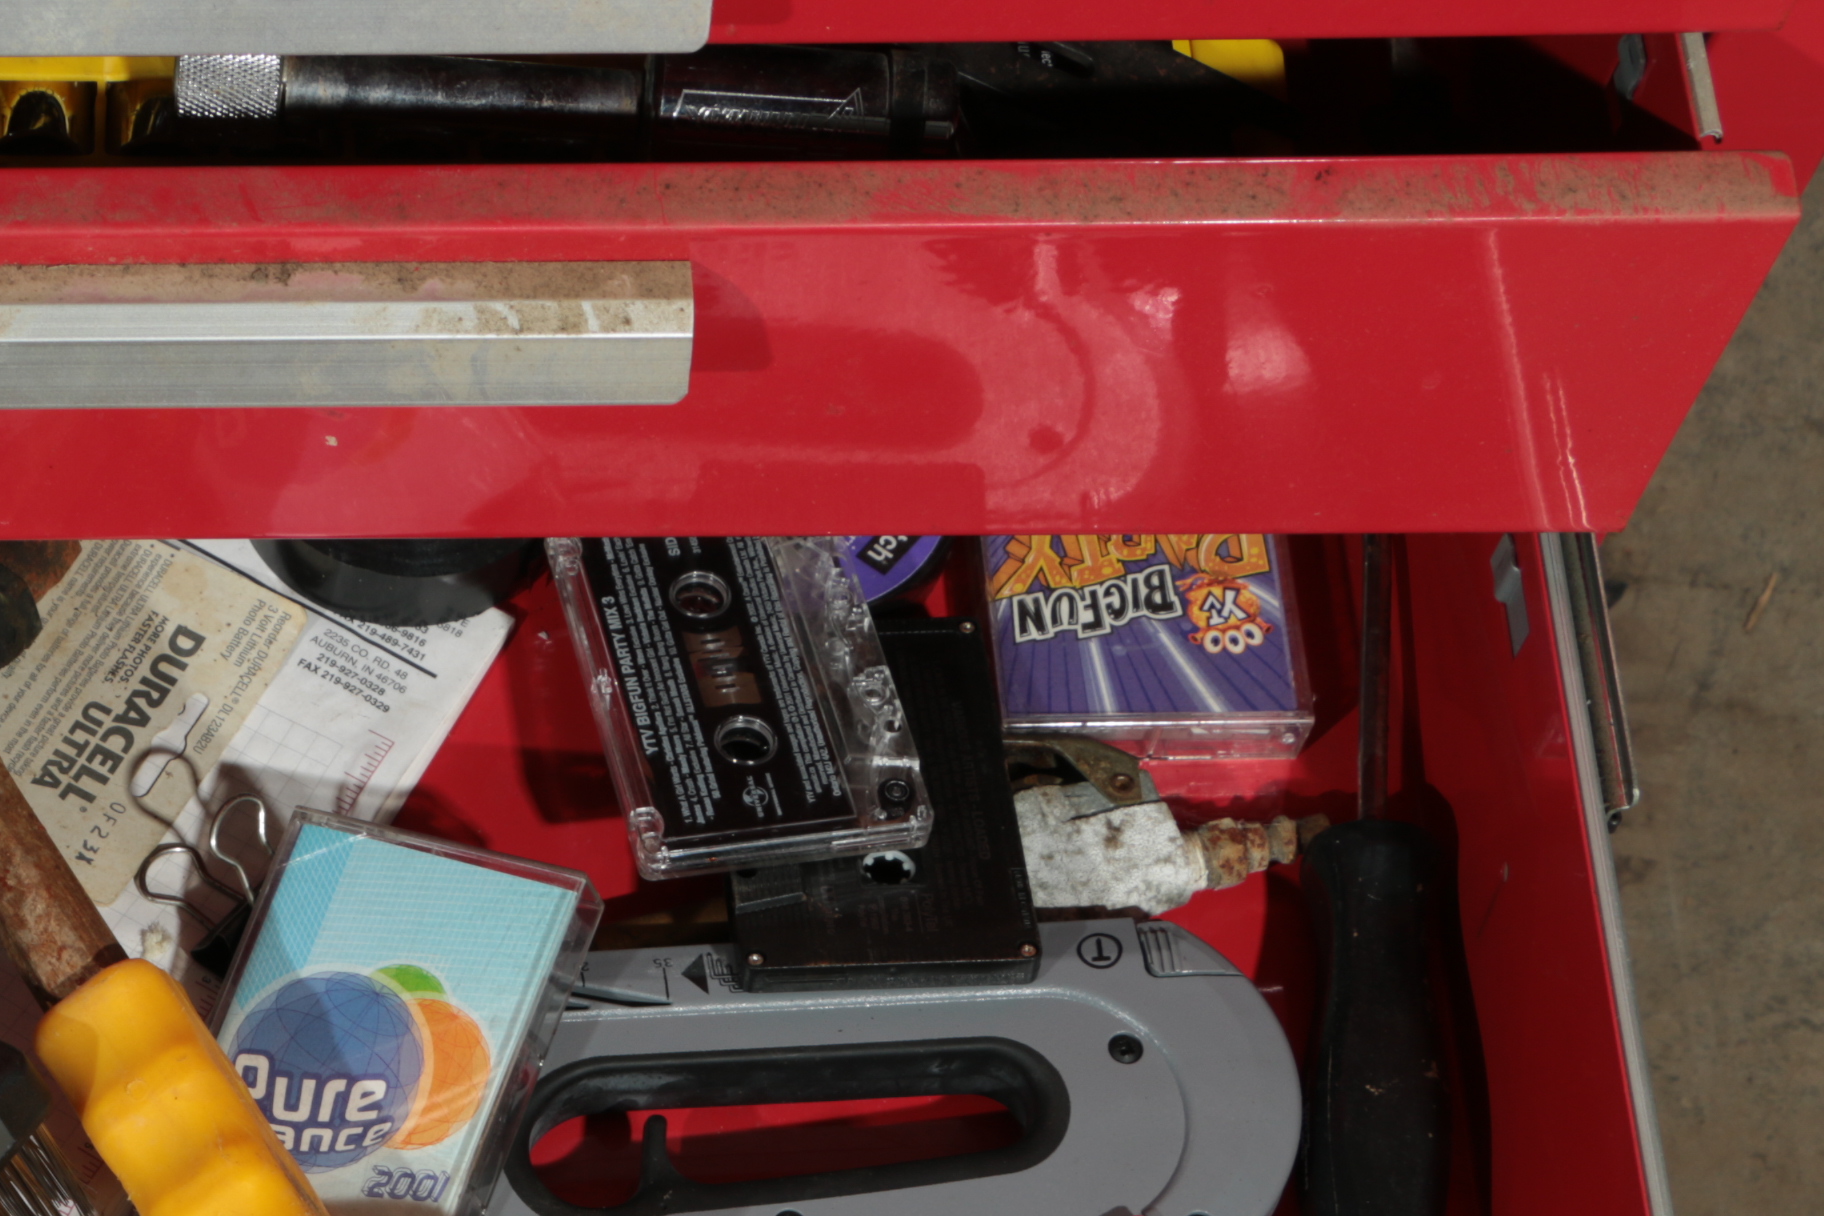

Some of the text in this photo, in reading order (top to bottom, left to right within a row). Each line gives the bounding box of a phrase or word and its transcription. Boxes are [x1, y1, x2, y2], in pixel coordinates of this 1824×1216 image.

[218, 597, 267, 662] Photo Battery
[260, 609, 292, 649] Reorder
[1010, 563, 1181, 643] BIGFUN
[100, 609, 159, 687] FASTER FLASHES.
[116, 614, 171, 687] MORE PHOTOS.
[231, 603, 278, 669] 3 Volt Lithium
[308, 633, 408, 695] AUBURN, IN 46706
[322, 627, 409, 681] 2235 CO. RD. 48
[296, 657, 391, 716] FAX 219-927-0329
[315, 651, 386, 698] 219-927-0328
[600, 595, 659, 754] YTV BIGFUN PARTY MIX 3
[29, 696, 113, 796] ULTRA
[191, 701, 233, 756] DL123AB2U
[652, 957, 672, 967] 35
[234, 1045, 389, 1128] Pure
[361, 1161, 451, 1207] 2001
